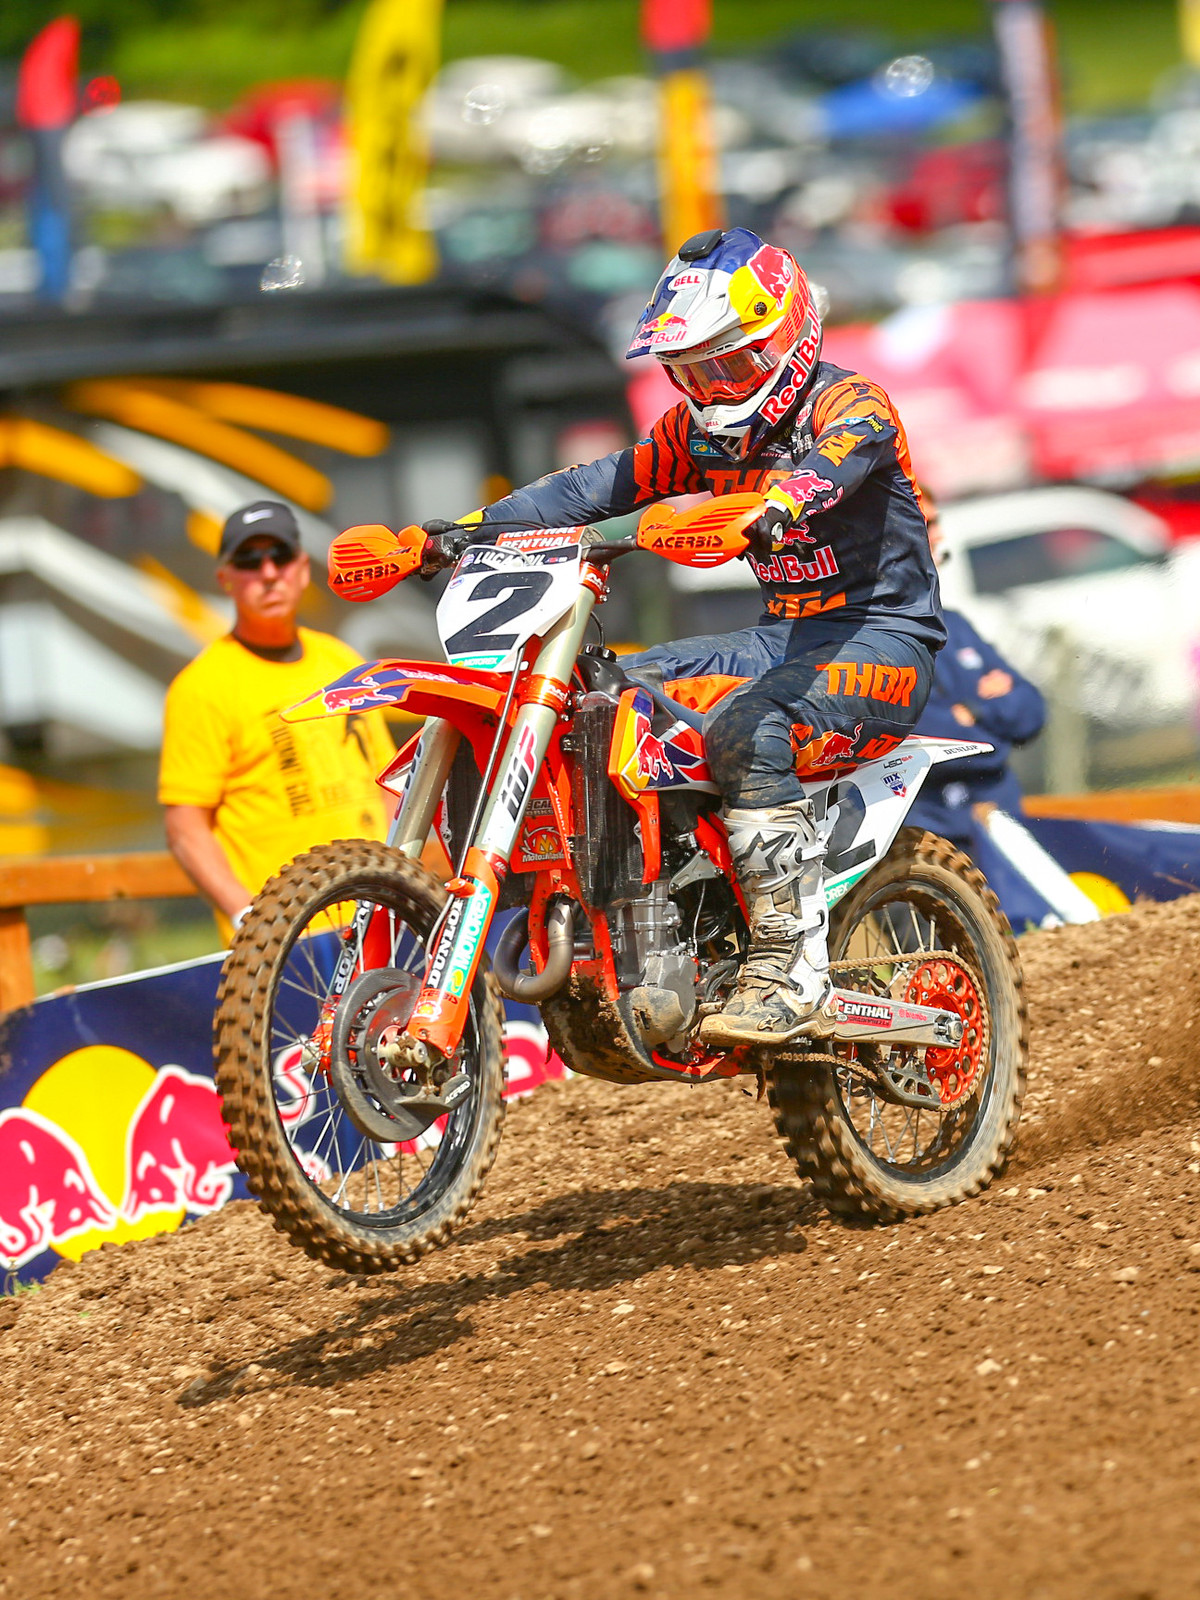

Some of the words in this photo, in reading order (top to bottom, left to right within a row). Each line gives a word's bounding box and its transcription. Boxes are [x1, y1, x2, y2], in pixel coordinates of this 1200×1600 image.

[673, 275, 701, 288] BELL
[655, 330, 687, 344] Bull
[758, 357, 809, 427] Red
[797, 301, 821, 369] Bull
[704, 469, 793, 498] THO
[651, 535, 724, 550] ACERBIS
[473, 551, 524, 566] LUCA
[781, 545, 839, 582] Bull
[333, 562, 400, 585] ACERBIS
[444, 571, 554, 656] 2
[463, 656, 499, 666] MOTOREX
[815, 662, 918, 707] THOR
[856, 733, 905, 760] KT
[943, 744, 979, 756] DUNLOP
[825, 881, 850, 901] OREX
[453, 884, 491, 971] MOTOREX
[427, 897, 464, 989] DUNLOP
